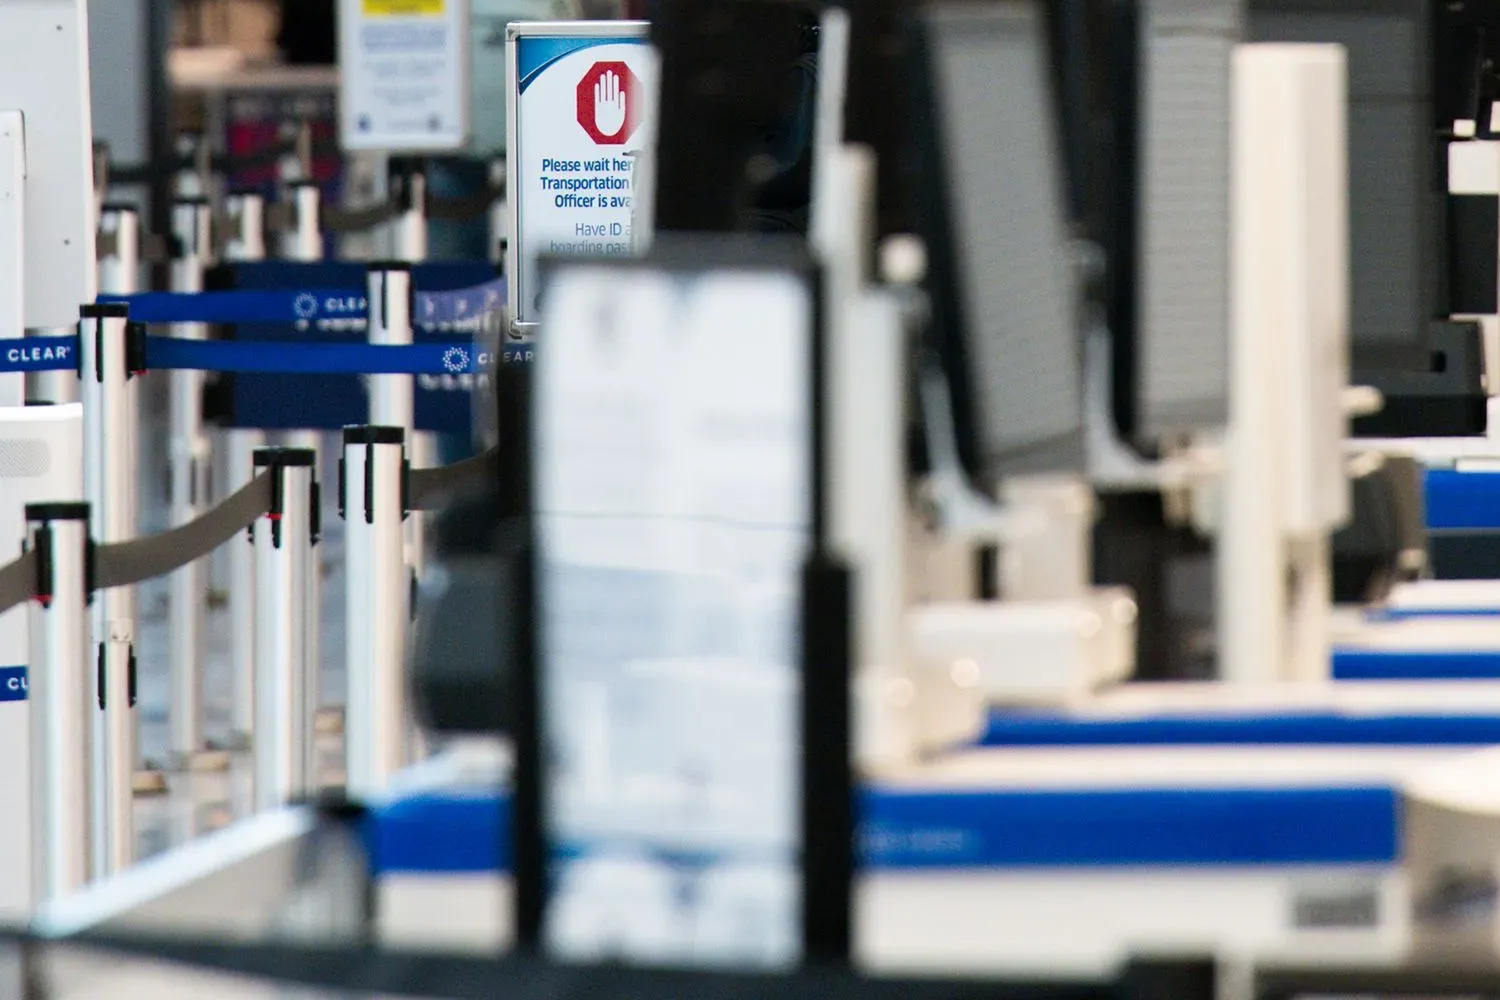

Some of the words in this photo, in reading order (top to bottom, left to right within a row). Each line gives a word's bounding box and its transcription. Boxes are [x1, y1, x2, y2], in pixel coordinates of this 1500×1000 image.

[542, 158, 581, 172] Please
[583, 158, 610, 172] wait
[612, 158, 632, 172] her
[540, 176, 630, 192] Transportation
[554, 194, 596, 208] Officer
[598, 194, 608, 208] is
[575, 222, 606, 236] Have
[609, 222, 623, 236] ID
[550, 240, 603, 255] boarding
[324, 296, 368, 312] CLEA
[8, 345, 67, 363] CLEAR
